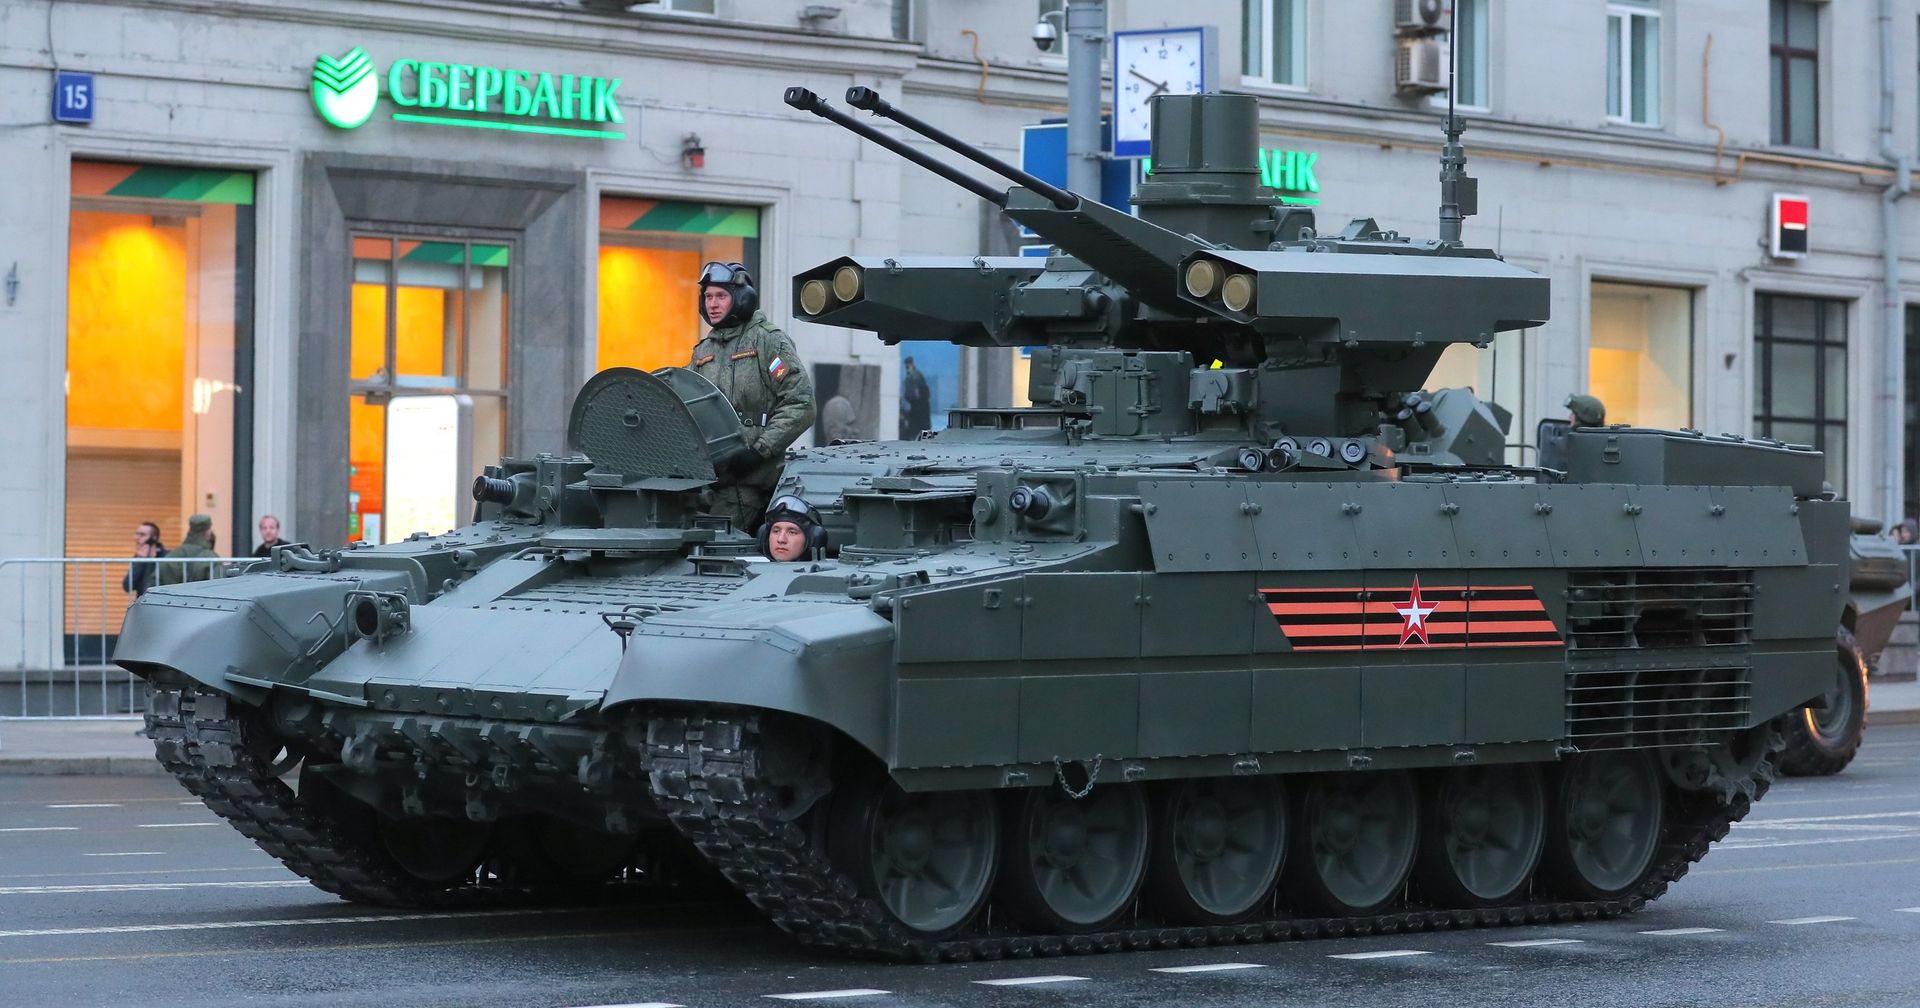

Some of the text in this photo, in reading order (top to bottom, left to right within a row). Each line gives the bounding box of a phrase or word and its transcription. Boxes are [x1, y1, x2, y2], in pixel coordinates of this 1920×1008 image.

[1158, 49, 1168, 60] 12
[388, 58, 625, 123] СБЕРБАНК
[1133, 83, 1140, 93] 9
[1186, 81, 1193, 91] 3
[64, 84, 88, 110] 15
